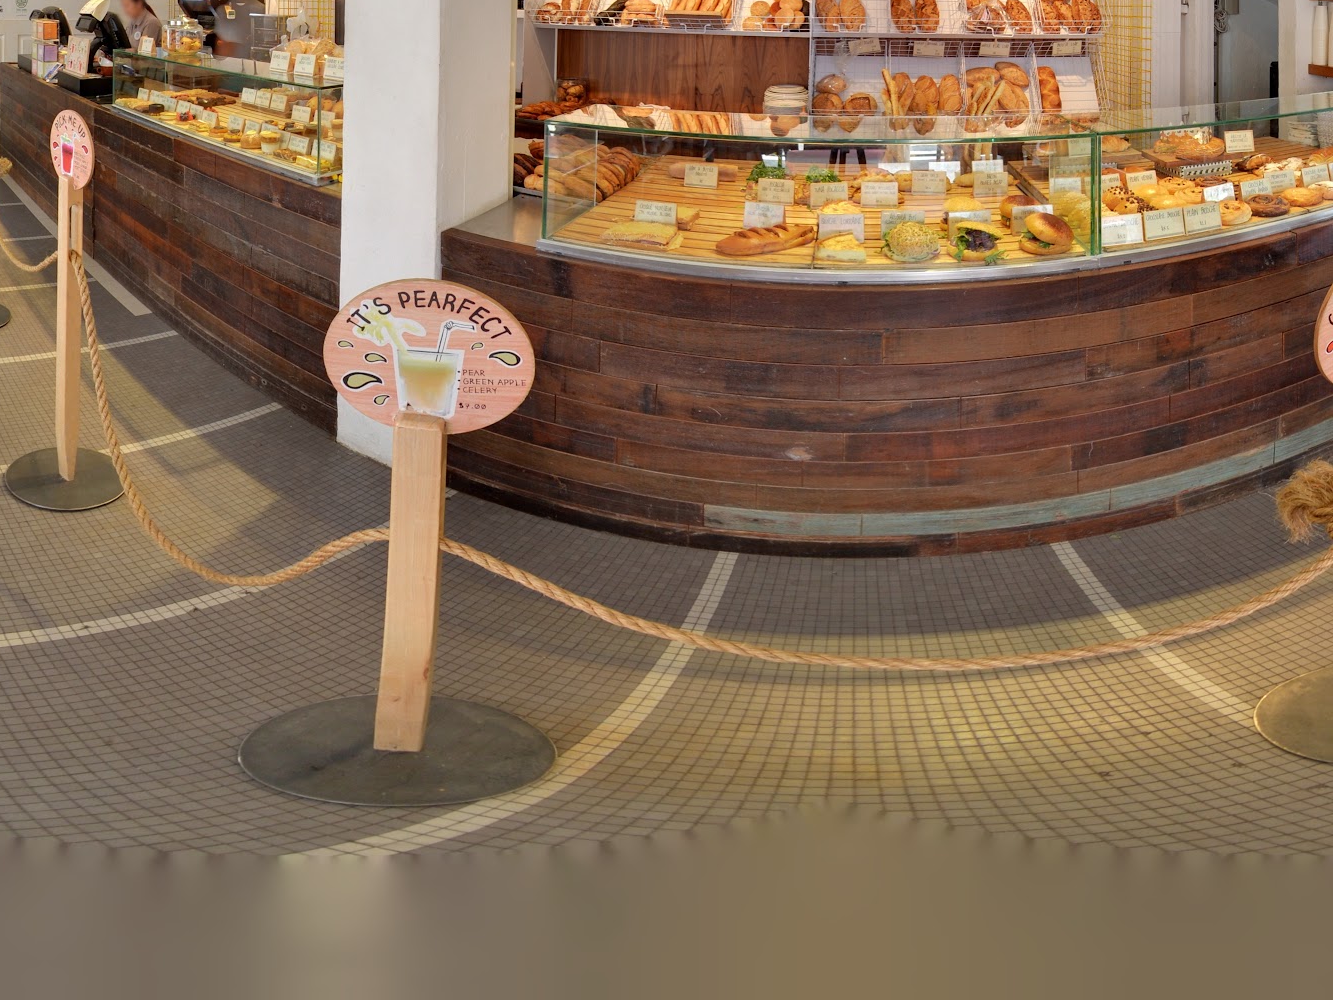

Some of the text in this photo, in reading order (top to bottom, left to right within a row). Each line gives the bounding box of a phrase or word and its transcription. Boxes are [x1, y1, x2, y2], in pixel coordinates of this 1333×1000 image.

[54, 115, 86, 139] PICK ME UP
[1186, 209, 1199, 217] PLAIN
[346, 290, 513, 339] IT'S PEARFECT
[462, 369, 485, 377] PEAR
[497, 379, 527, 387] APPLE
[462, 386, 498, 394] CELERY
